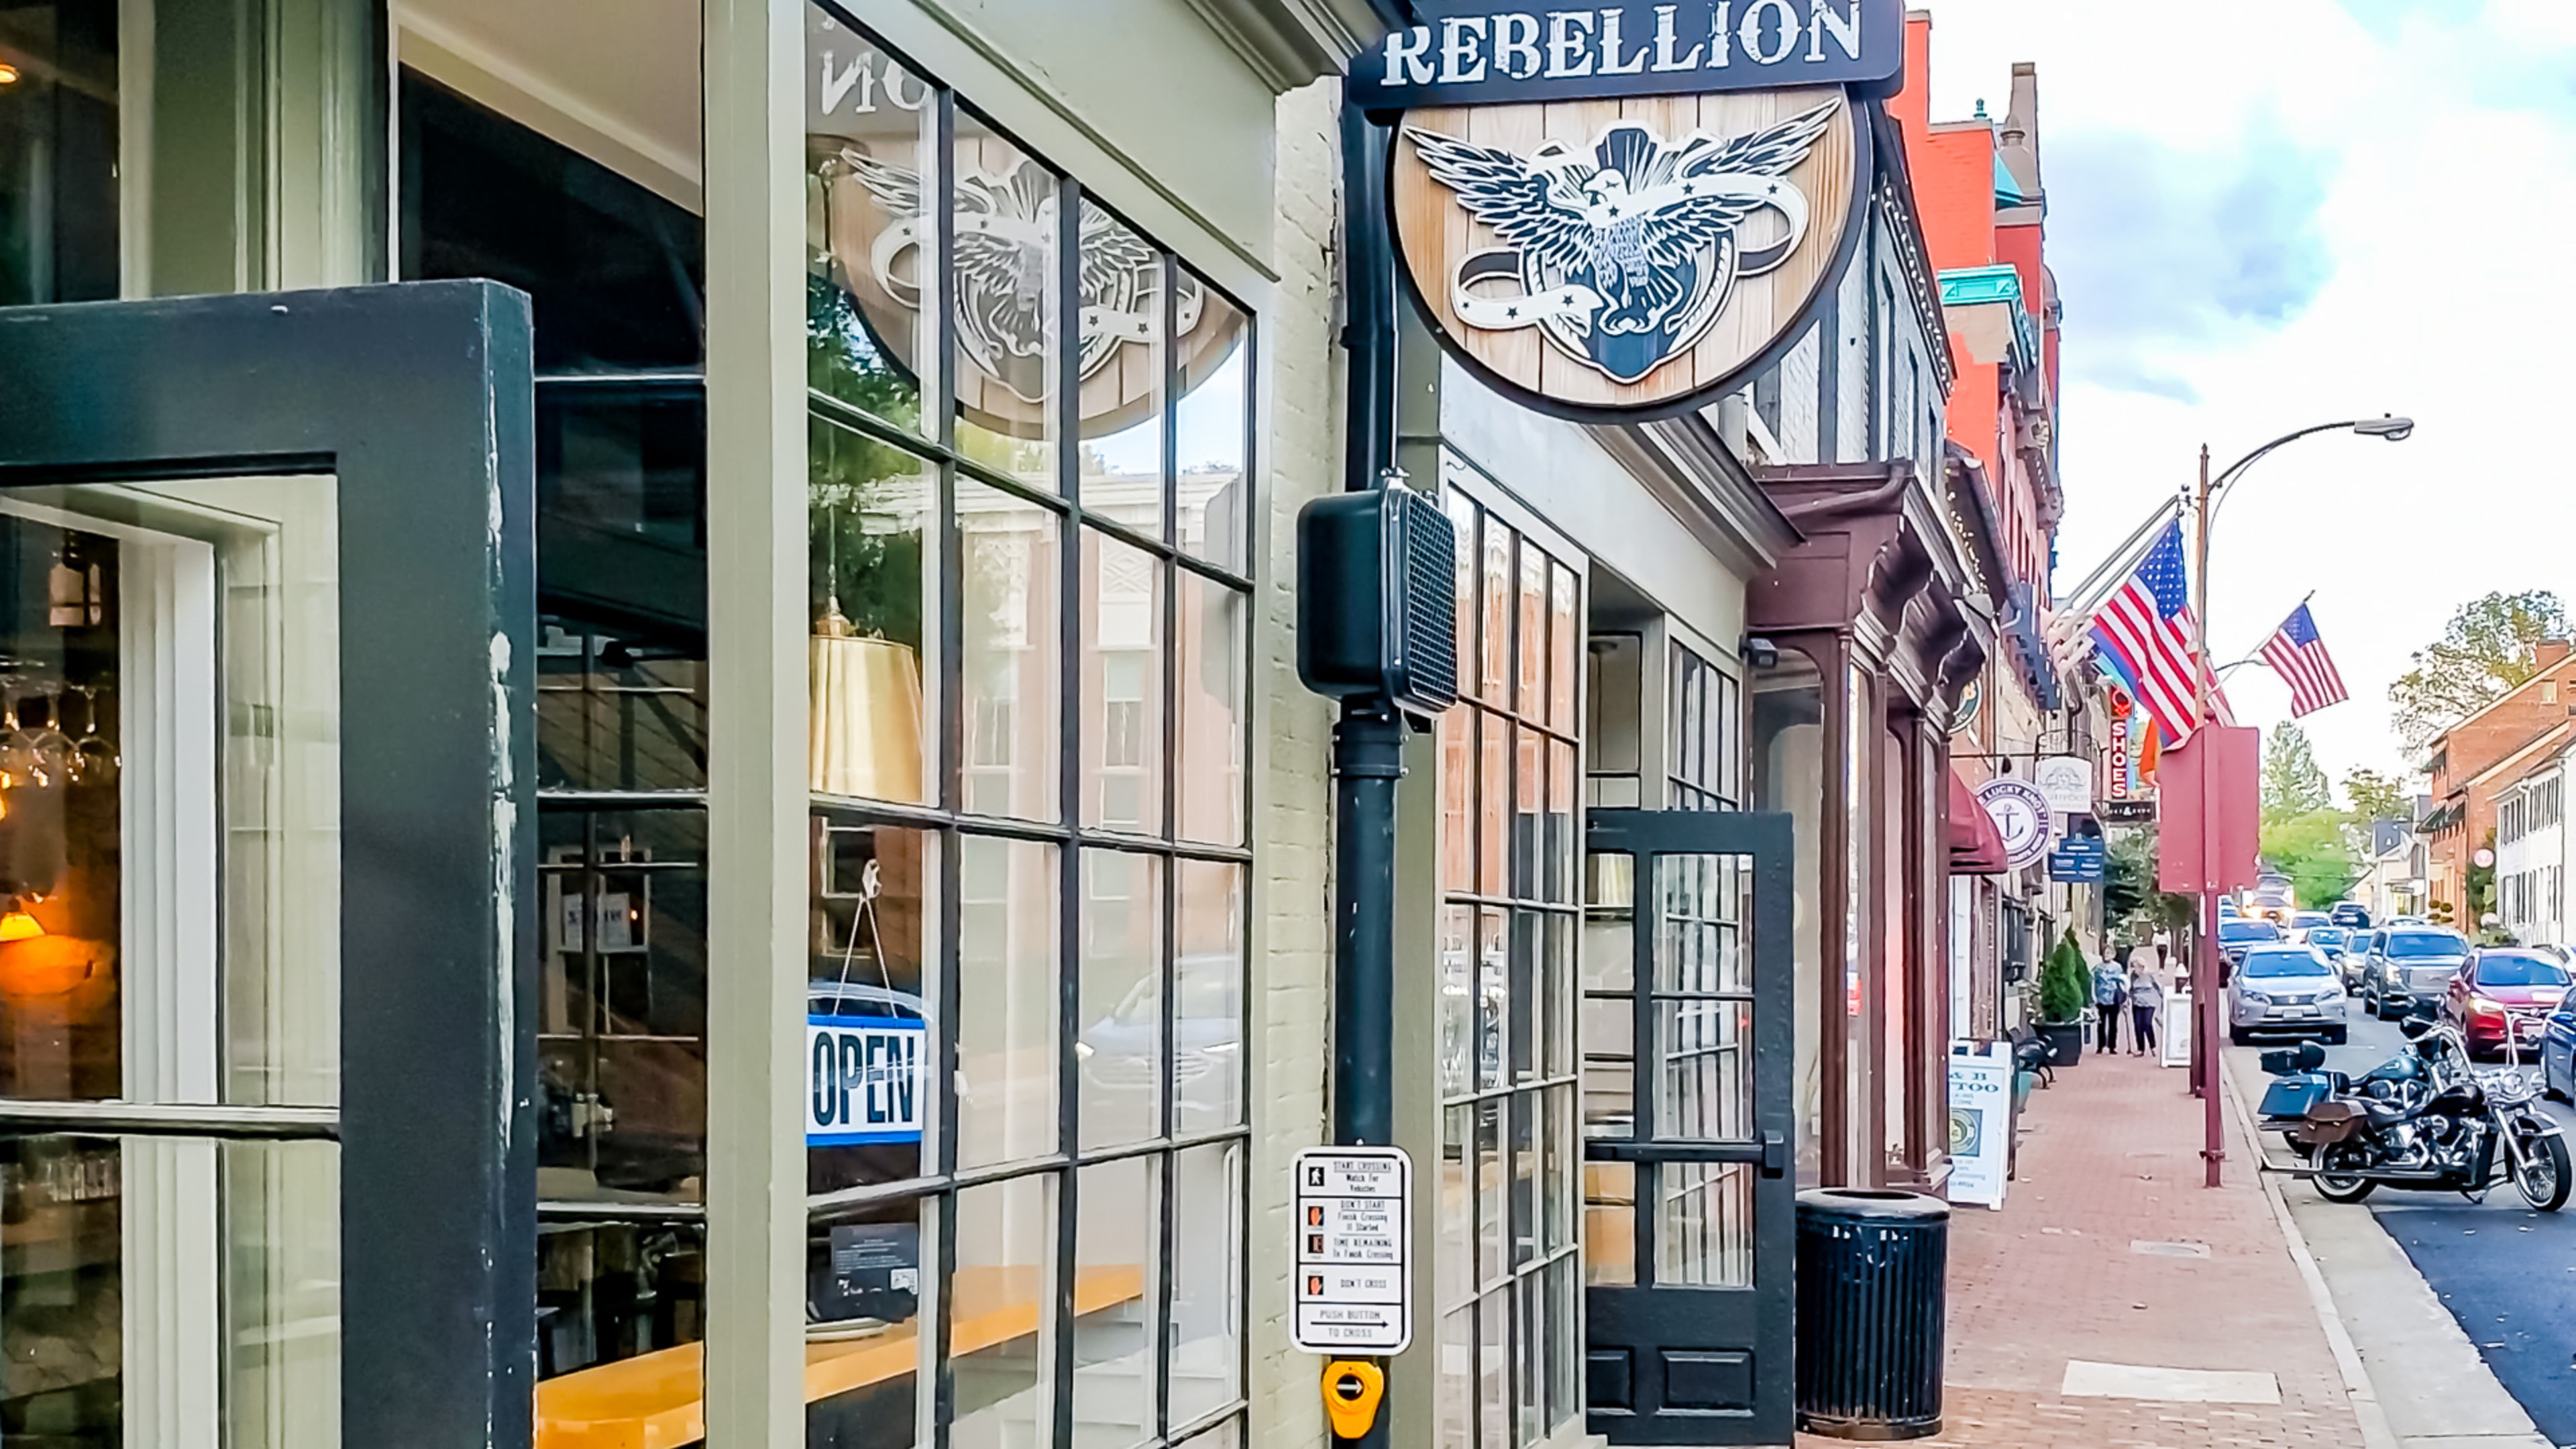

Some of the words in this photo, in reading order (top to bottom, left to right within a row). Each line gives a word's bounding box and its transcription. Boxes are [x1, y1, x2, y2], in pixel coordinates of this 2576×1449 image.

[1380, 0, 1860, 87] REBELLION
[2112, 721, 2127, 798] SHOES
[1985, 785, 2022, 798] LUCKY
[2022, 789, 2047, 818] KNOT
[813, 1031, 914, 1127] OPEN
[1320, 1310, 1343, 1319] PUSH
[1348, 1310, 1381, 1320] BUTTON
[1329, 1328, 1339, 1336] TO
[1344, 1328, 1373, 1338] CROSS
